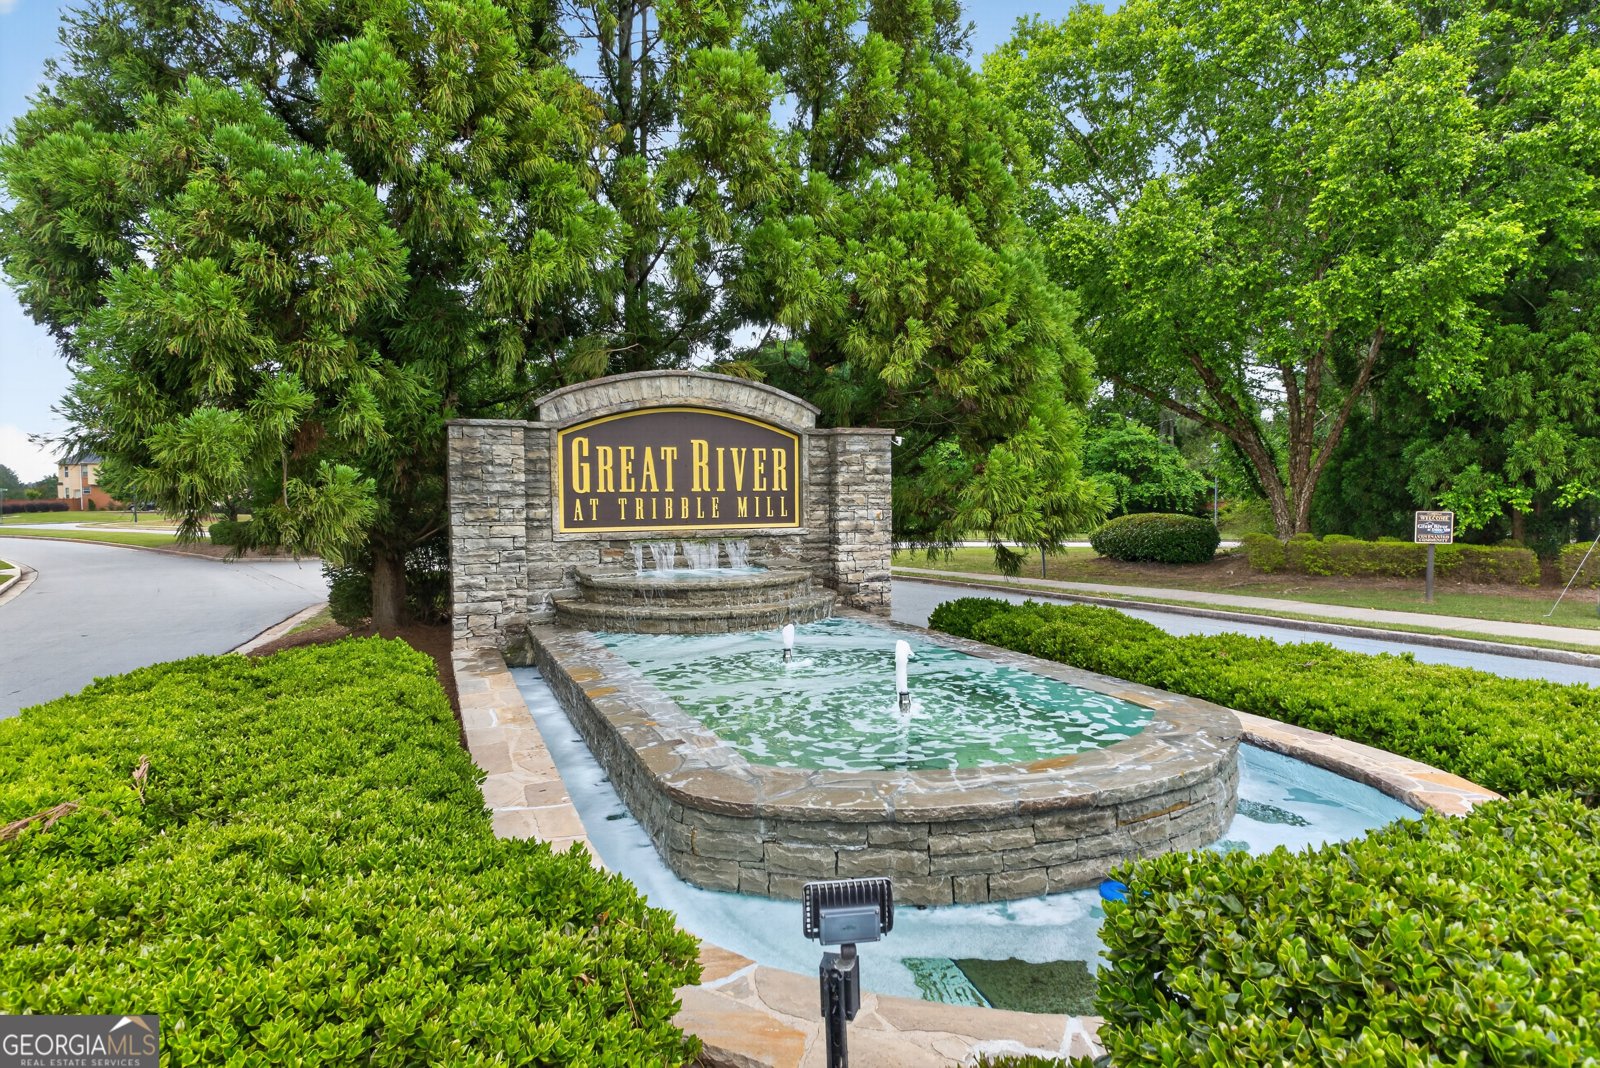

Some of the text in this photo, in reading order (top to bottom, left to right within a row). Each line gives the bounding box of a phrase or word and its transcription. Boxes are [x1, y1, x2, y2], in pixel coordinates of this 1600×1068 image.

[572, 437, 788, 494] GREAT RIVER
[573, 496, 788, 521] AT TRIBBLE MILL
